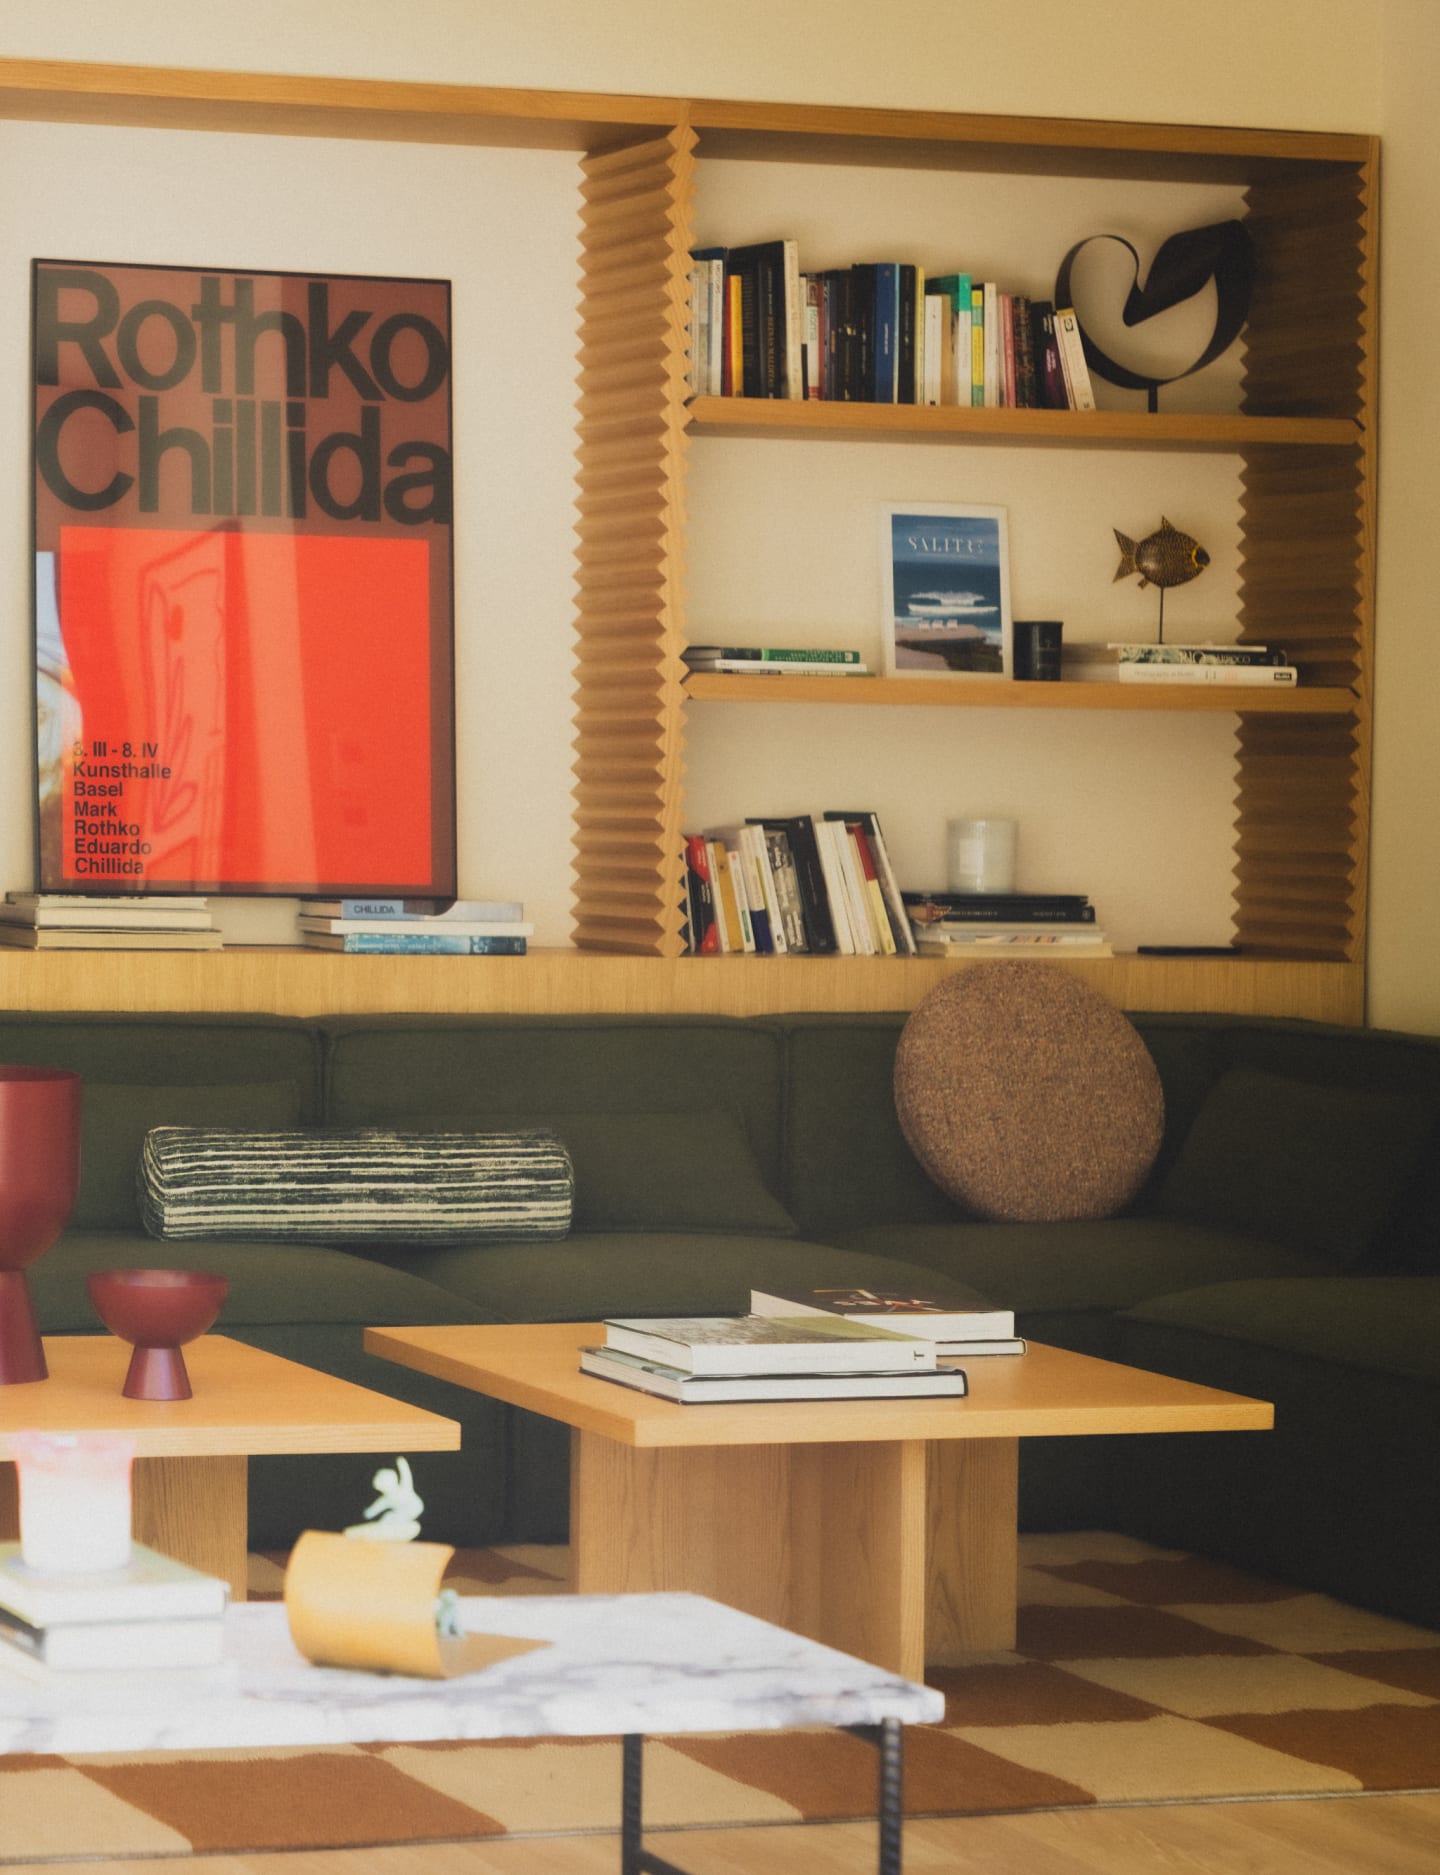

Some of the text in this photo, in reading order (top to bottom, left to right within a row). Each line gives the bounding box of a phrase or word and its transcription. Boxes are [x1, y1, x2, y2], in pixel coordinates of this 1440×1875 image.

[37, 269, 449, 402] Rothko
[37, 389, 450, 525] Chillida
[908, 536, 984, 553] SALITRE
[72, 742, 88, 757] 3.
[92, 742, 107, 757] III
[121, 743, 137, 758] 8.
[142, 743, 158, 758] IV
[73, 762, 172, 779] Kunsthalle
[74, 782, 123, 797] Basel
[74, 802, 117, 817] Mark
[74, 820, 140, 836] Rothko
[74, 838, 152, 855] Eduardo
[74, 858, 144, 874] Chillida
[353, 904, 396, 915] CHILLIDA
